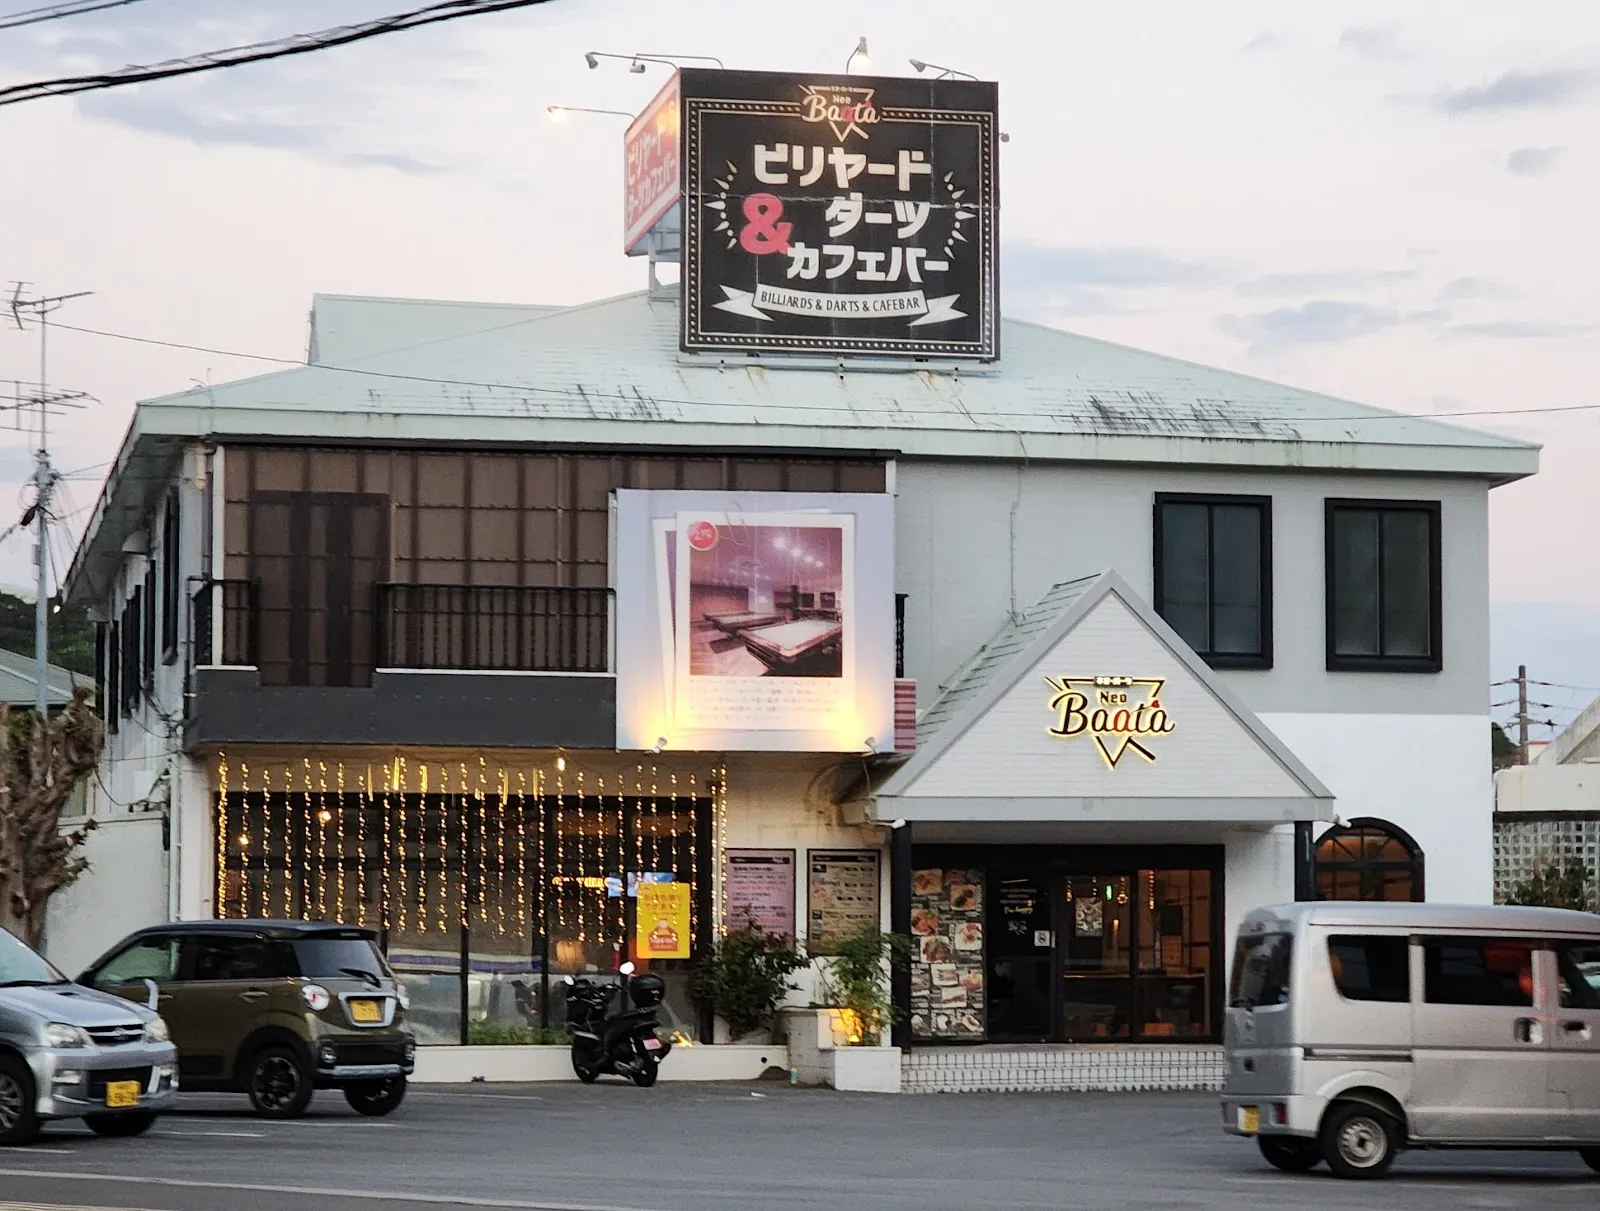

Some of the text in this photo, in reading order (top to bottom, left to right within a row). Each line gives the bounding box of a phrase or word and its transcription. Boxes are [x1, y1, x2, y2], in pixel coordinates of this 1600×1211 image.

[754, 143, 932, 191] ビリヤード
[739, 192, 931, 256] & ダーツ
[786, 242, 949, 283] カフェバー
[760, 290, 921, 312] BILLIARDS & DARTS & CAFEBAR
[1049, 692, 1176, 735] Baata
[1100, 691, 1127, 703] Neo
